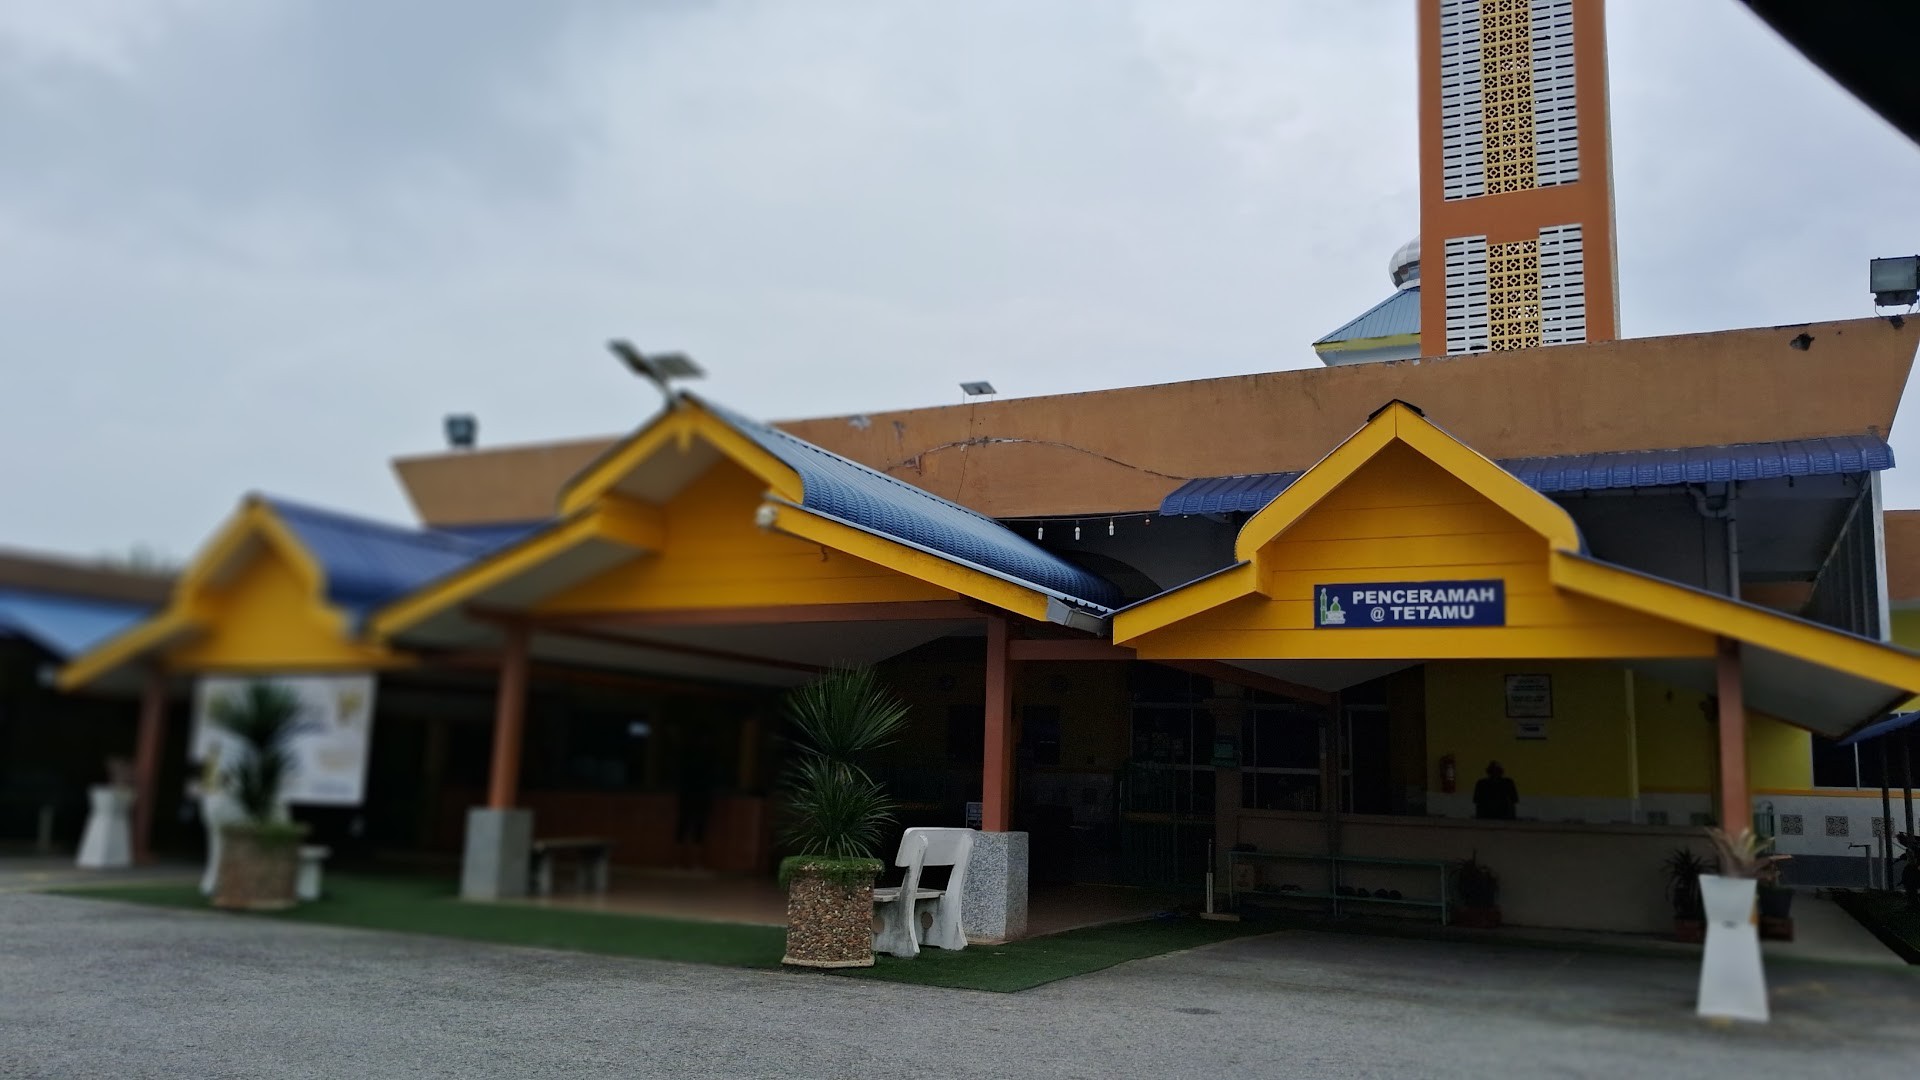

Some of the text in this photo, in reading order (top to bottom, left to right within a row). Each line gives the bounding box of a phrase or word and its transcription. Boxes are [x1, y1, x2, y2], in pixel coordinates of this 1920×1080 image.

[1352, 588, 1494, 604] PENCERAMAH
[1370, 605, 1475, 622] @ TETAMU
